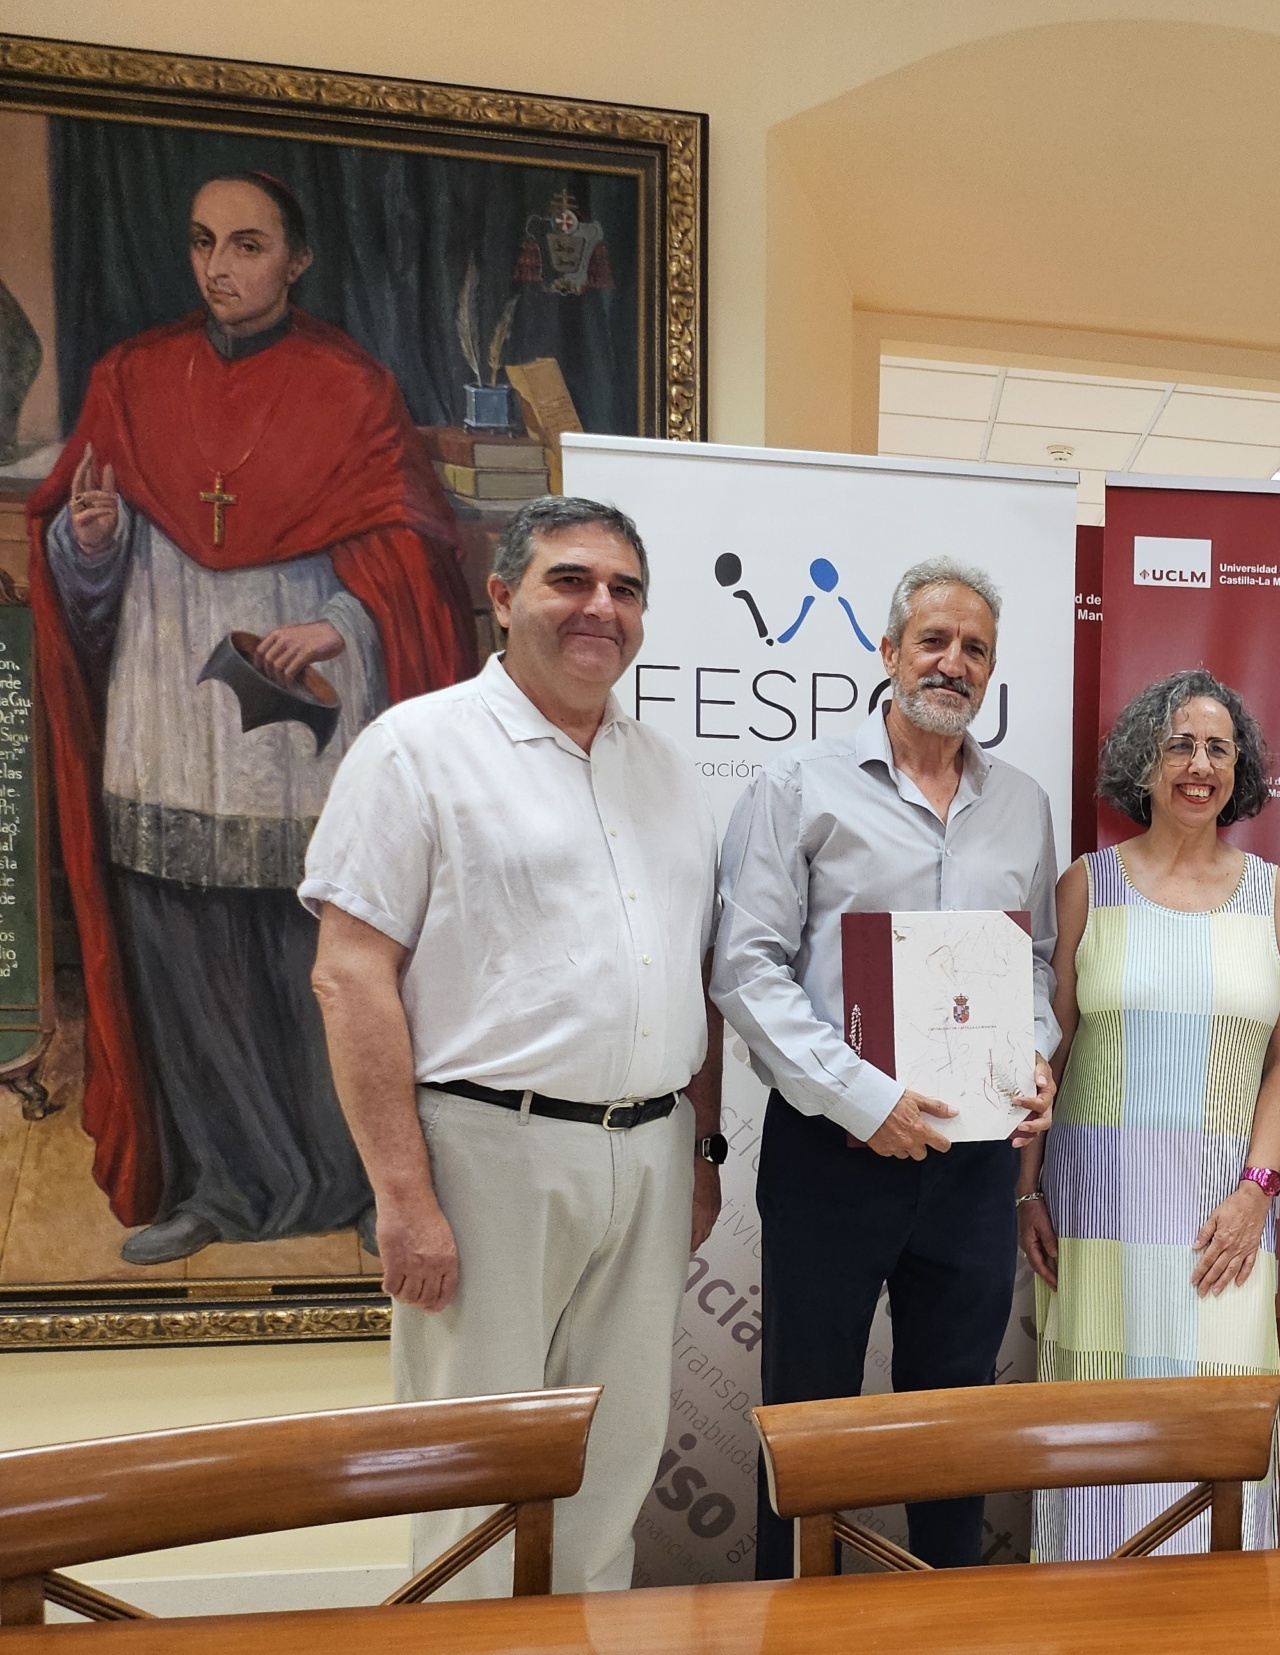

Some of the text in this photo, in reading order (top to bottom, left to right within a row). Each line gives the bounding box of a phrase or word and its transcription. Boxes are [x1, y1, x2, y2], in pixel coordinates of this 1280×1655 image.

[1152, 569, 1206, 583] UCLM
[1219, 563, 1278, 574] Universidad
[1219, 575, 1270, 586] Castilla-La
[1077, 609, 1103, 621] Man
[1086, 593, 1102, 605] de
[635, 664, 1009, 750] FESPU
[684, 1250, 762, 1352] ncia
[672, 1326, 758, 1425] Transp
[670, 1387, 759, 1485] Amabilida
[652, 1432, 737, 1550] iso
